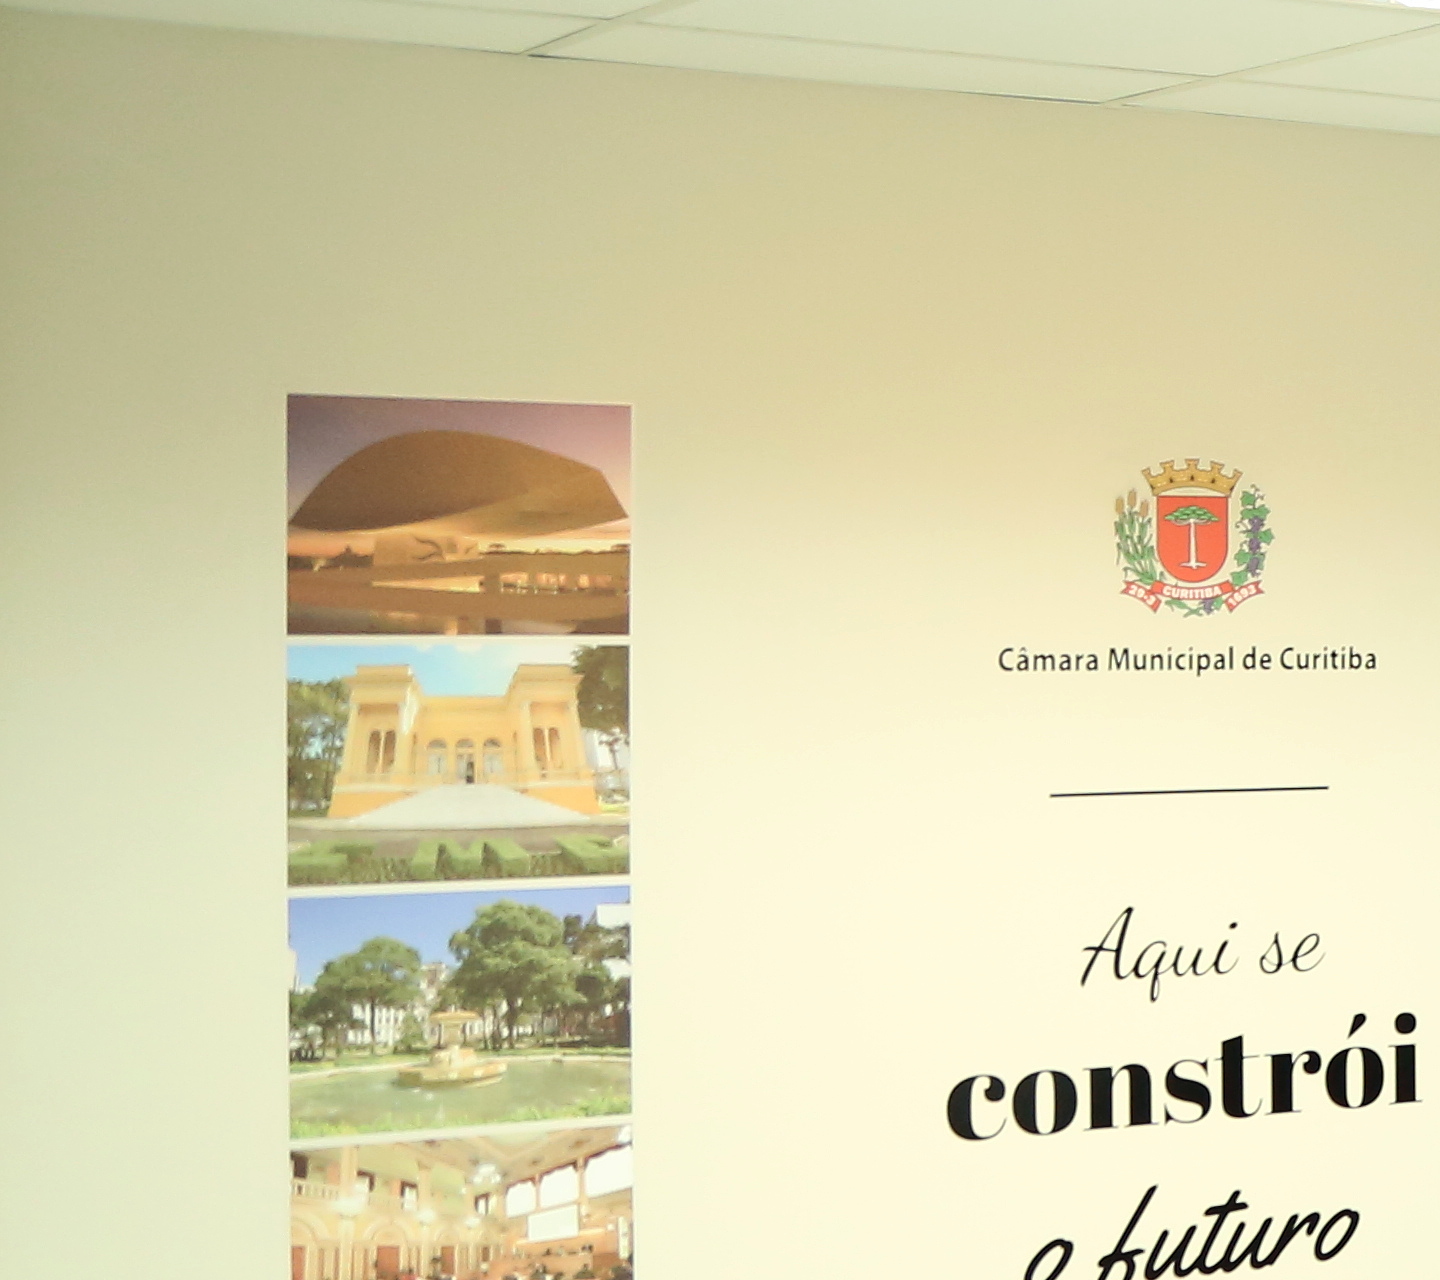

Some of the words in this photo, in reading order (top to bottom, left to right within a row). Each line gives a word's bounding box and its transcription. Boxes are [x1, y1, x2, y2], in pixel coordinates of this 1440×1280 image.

[1162, 584, 1223, 599] CURITIBA
[998, 647, 1099, 672] Câmara
[1107, 646, 1234, 677] Municipal
[1242, 646, 1272, 670] de
[1279, 646, 1377, 671] Curitiba
[1080, 904, 1238, 1003] Aqui
[1257, 925, 1325, 975] se
[945, 1012, 1423, 1141] constrói
